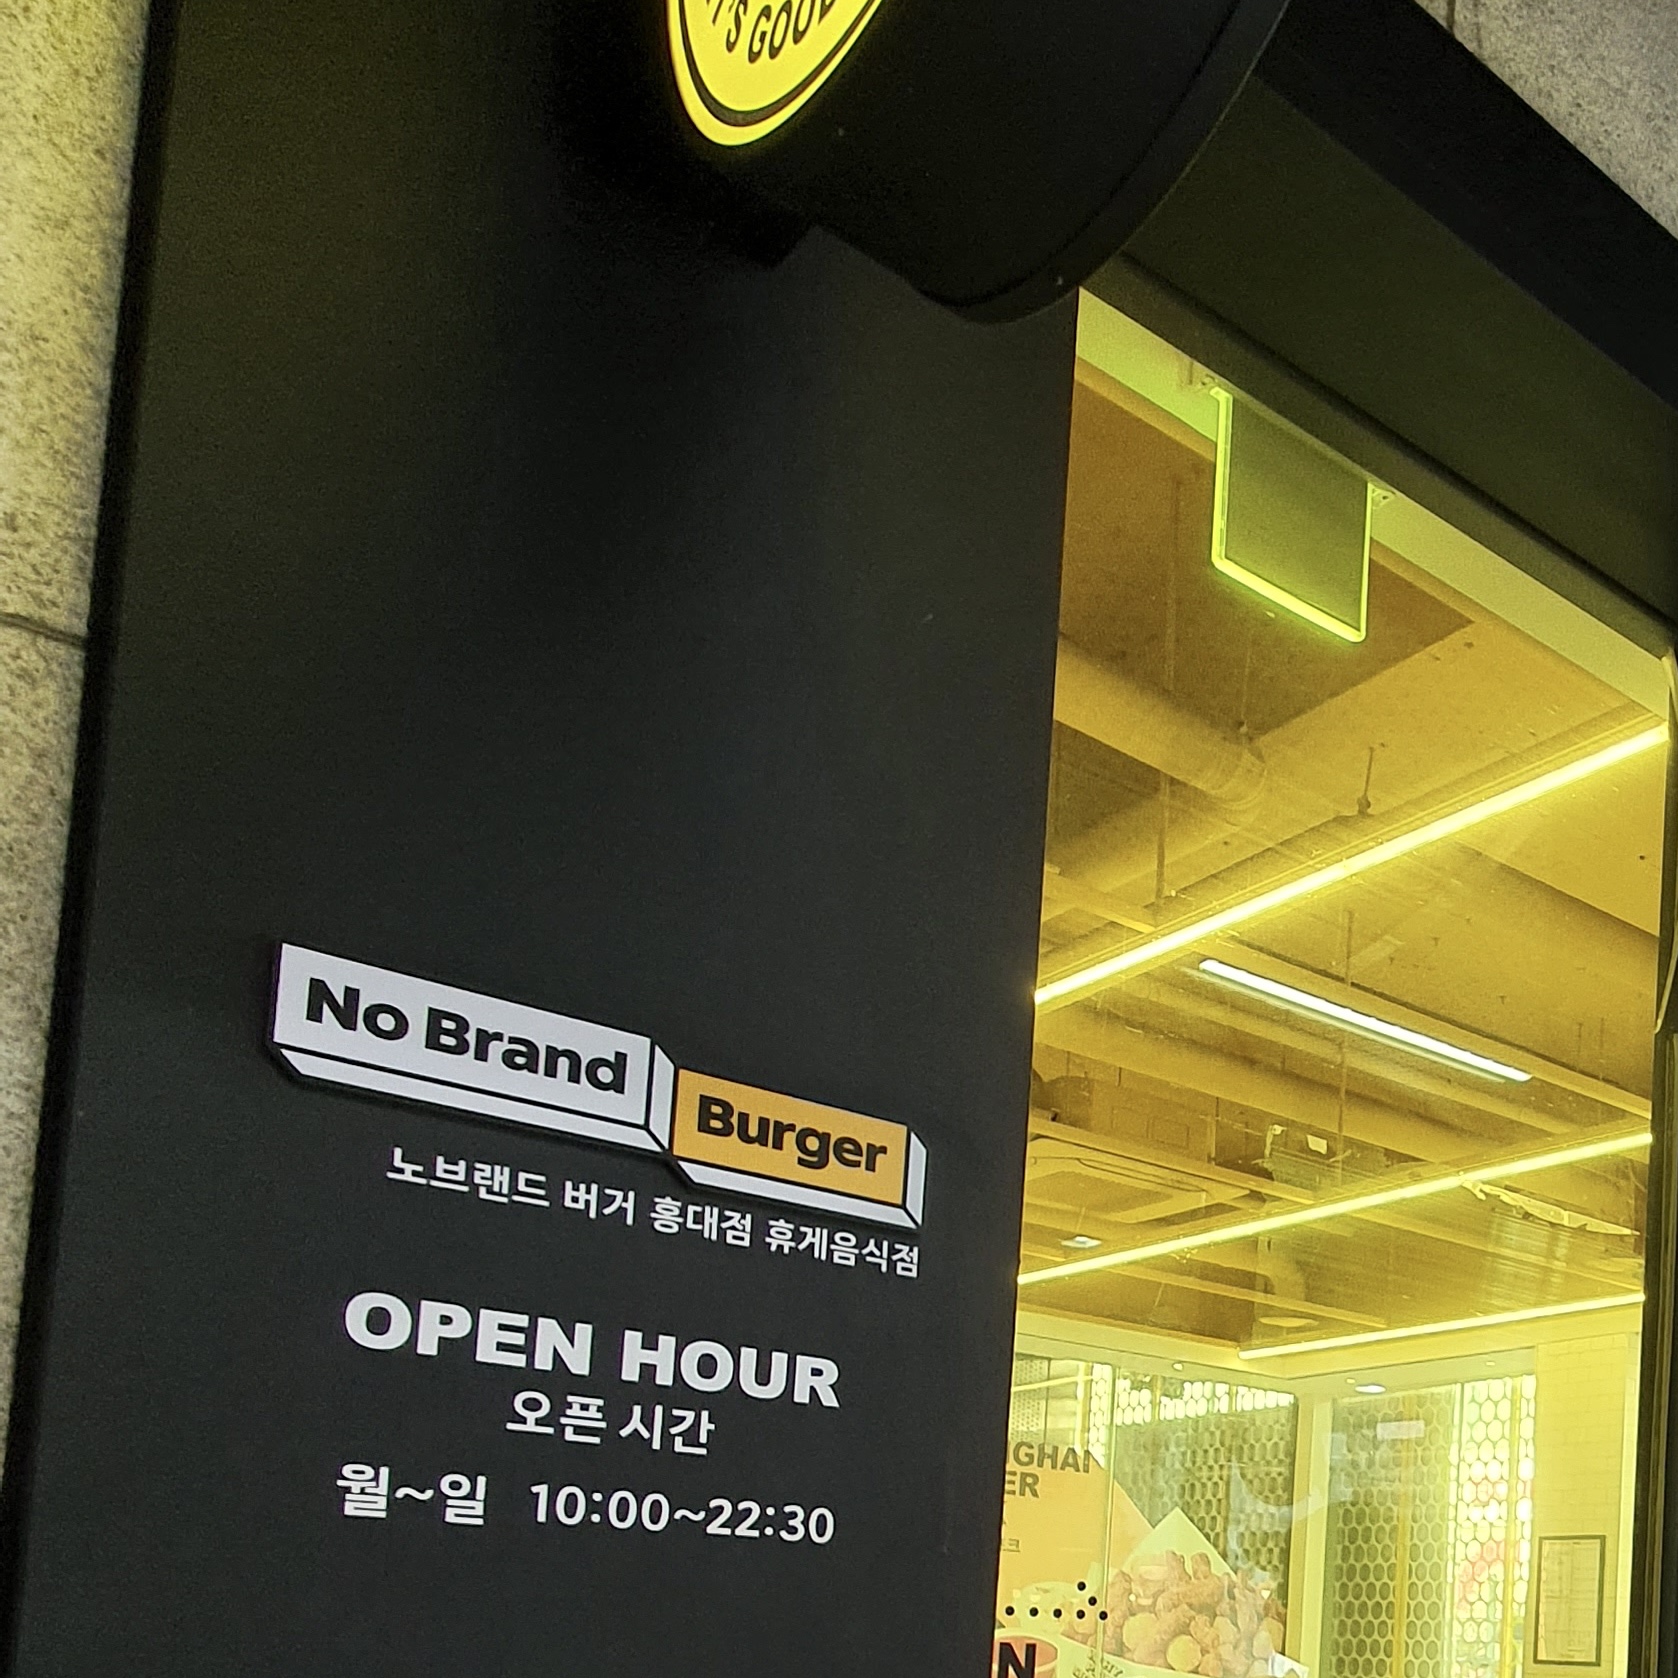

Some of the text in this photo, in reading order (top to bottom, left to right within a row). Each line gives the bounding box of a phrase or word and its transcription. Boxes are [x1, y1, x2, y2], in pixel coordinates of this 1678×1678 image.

[305, 977, 888, 1173] No Brand Burger
[386, 1147, 920, 1278] 노브랜드 버거 홍대점 휴게음식점
[344, 1291, 840, 1408] OPEN HOUR
[505, 1390, 716, 1455] 오픈 시간
[336, 1463, 835, 1544] 월~일 10:00~22:30
